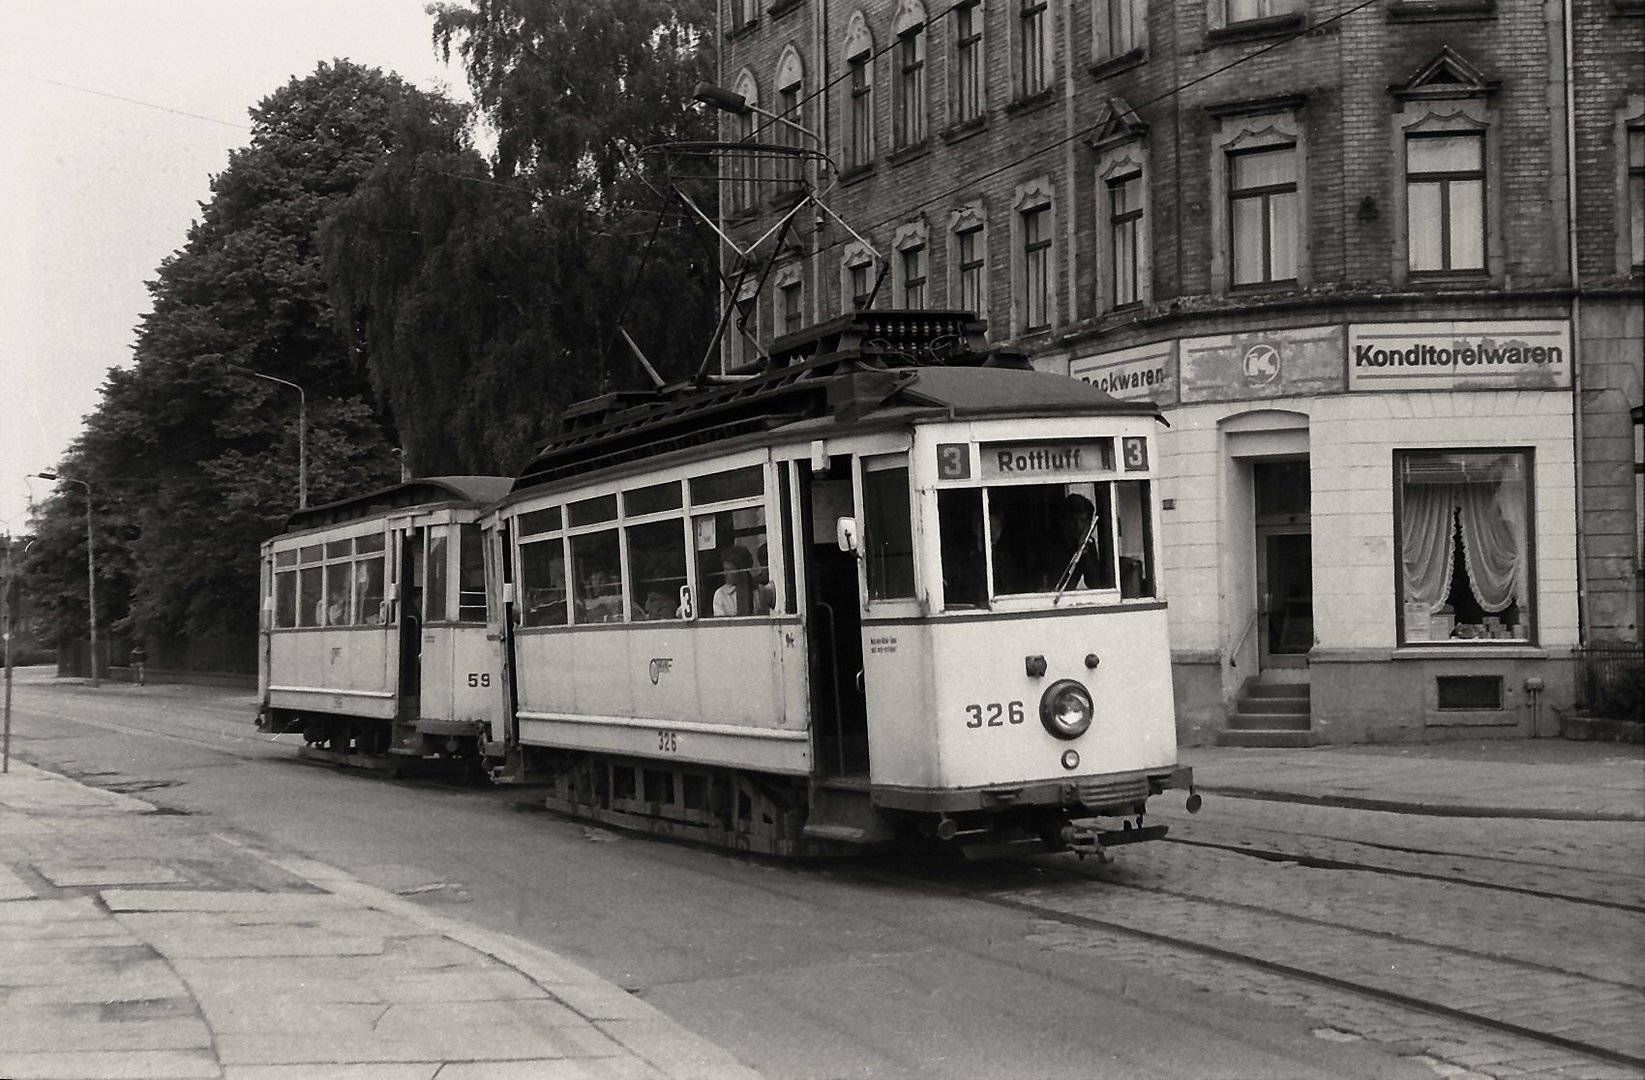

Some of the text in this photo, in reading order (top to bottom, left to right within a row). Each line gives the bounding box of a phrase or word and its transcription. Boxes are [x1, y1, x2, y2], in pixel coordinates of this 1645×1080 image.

[943, 447, 962, 475] 3
[997, 449, 1081, 472] Rottluff
[1127, 439, 1143, 466] 3
[682, 587, 693, 618] 3
[467, 673, 490, 688] 59
[965, 700, 1025, 729] 326
[658, 731, 677, 752] 326
